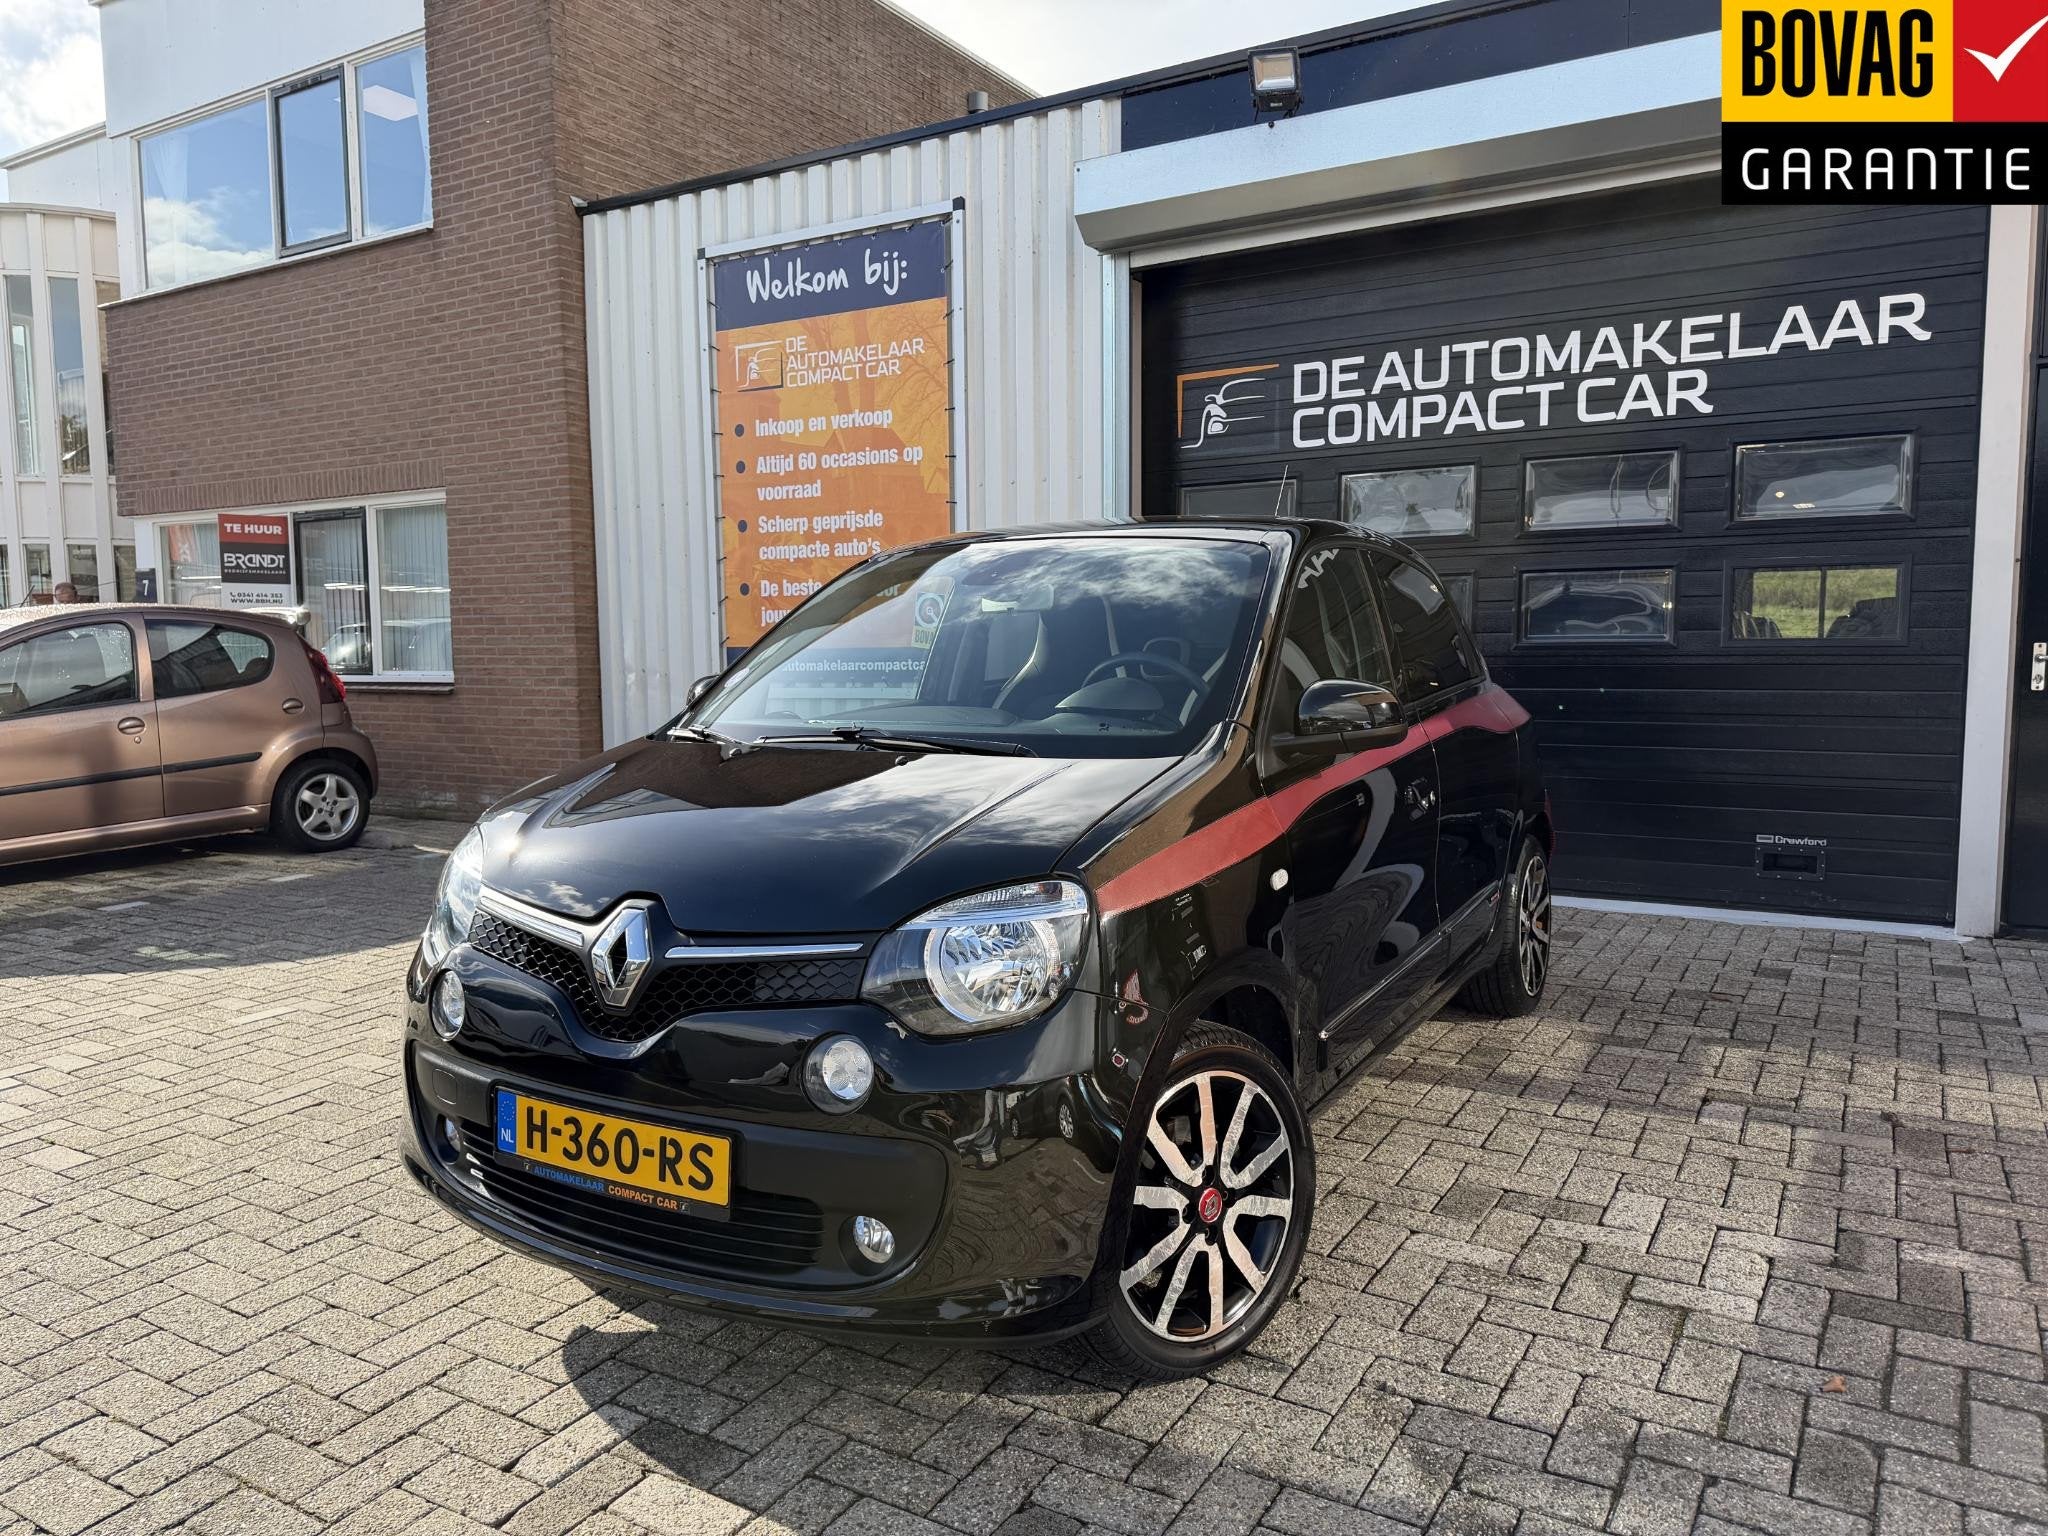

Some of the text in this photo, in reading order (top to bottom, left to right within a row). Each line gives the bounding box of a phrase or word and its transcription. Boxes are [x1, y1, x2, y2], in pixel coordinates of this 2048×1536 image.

[746, 248, 908, 304] Welkom bij:
[785, 335, 808, 354] DE
[786, 337, 925, 371] AUTOMAKELAAR
[1293, 292, 1932, 404] DE AUTOMAKELAAR
[786, 360, 901, 388] COMPACT CAR
[1292, 368, 1715, 448] COMPACT CAR
[755, 408, 893, 437] Inkoop en verkoop
[756, 445, 923, 476] Altijd 60 occasions op
[757, 479, 822, 501] voorraad
[223, 523, 282, 535] TE HUUR
[758, 509, 883, 535] Scherp geprijsde
[223, 552, 286, 569] BRANDT
[759, 537, 881, 562] compacte auto's
[142, 579, 149, 596] 7
[760, 578, 822, 597] De beste
[1775, 835, 1827, 846] Crawford
[500, 1126, 515, 1144] NL
[525, 1105, 715, 1191] H-360-RS
[534, 1166, 678, 1210] AUTOMAKELAAR COMPACT CAR
